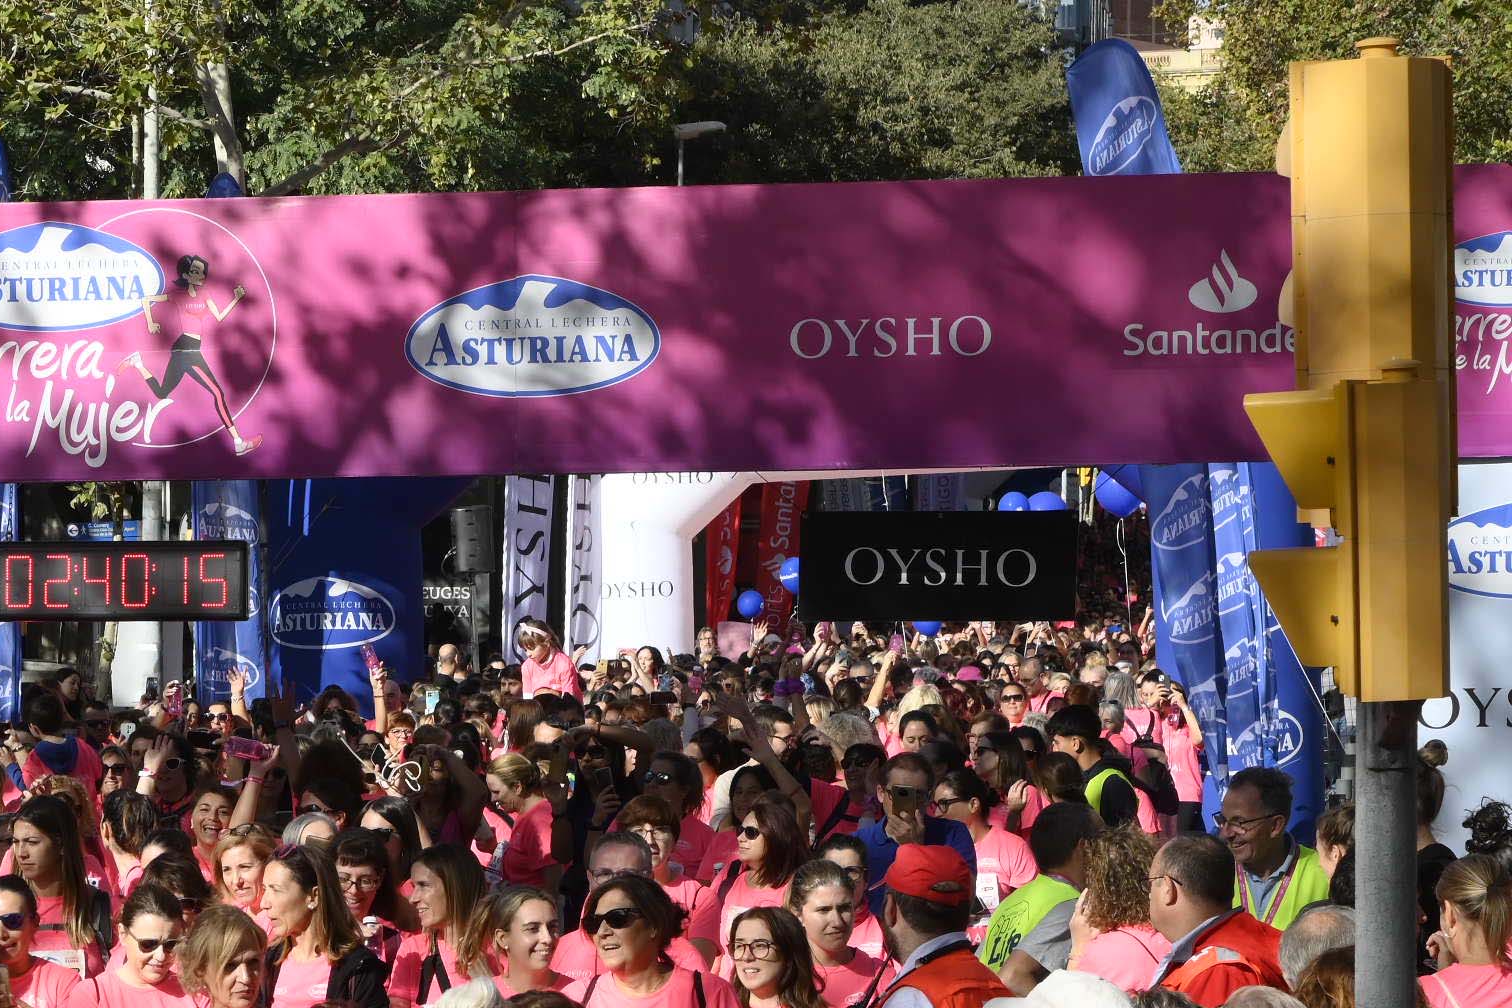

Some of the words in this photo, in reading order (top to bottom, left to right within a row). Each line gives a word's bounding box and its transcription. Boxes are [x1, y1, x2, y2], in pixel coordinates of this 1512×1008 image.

[424, 322, 641, 367] ASTURIANA
[465, 319, 543, 332] CENTRAL
[551, 316, 632, 328] LECHERA
[790, 315, 992, 359] OYSHO
[1123, 322, 1296, 356] Santande
[5, 383, 31, 423] la
[27, 372, 173, 467] Mujer
[5, 554, 227, 608] 02:40:15
[844, 546, 1038, 587] OYSHO
[274, 605, 386, 633] ASTURIANA
